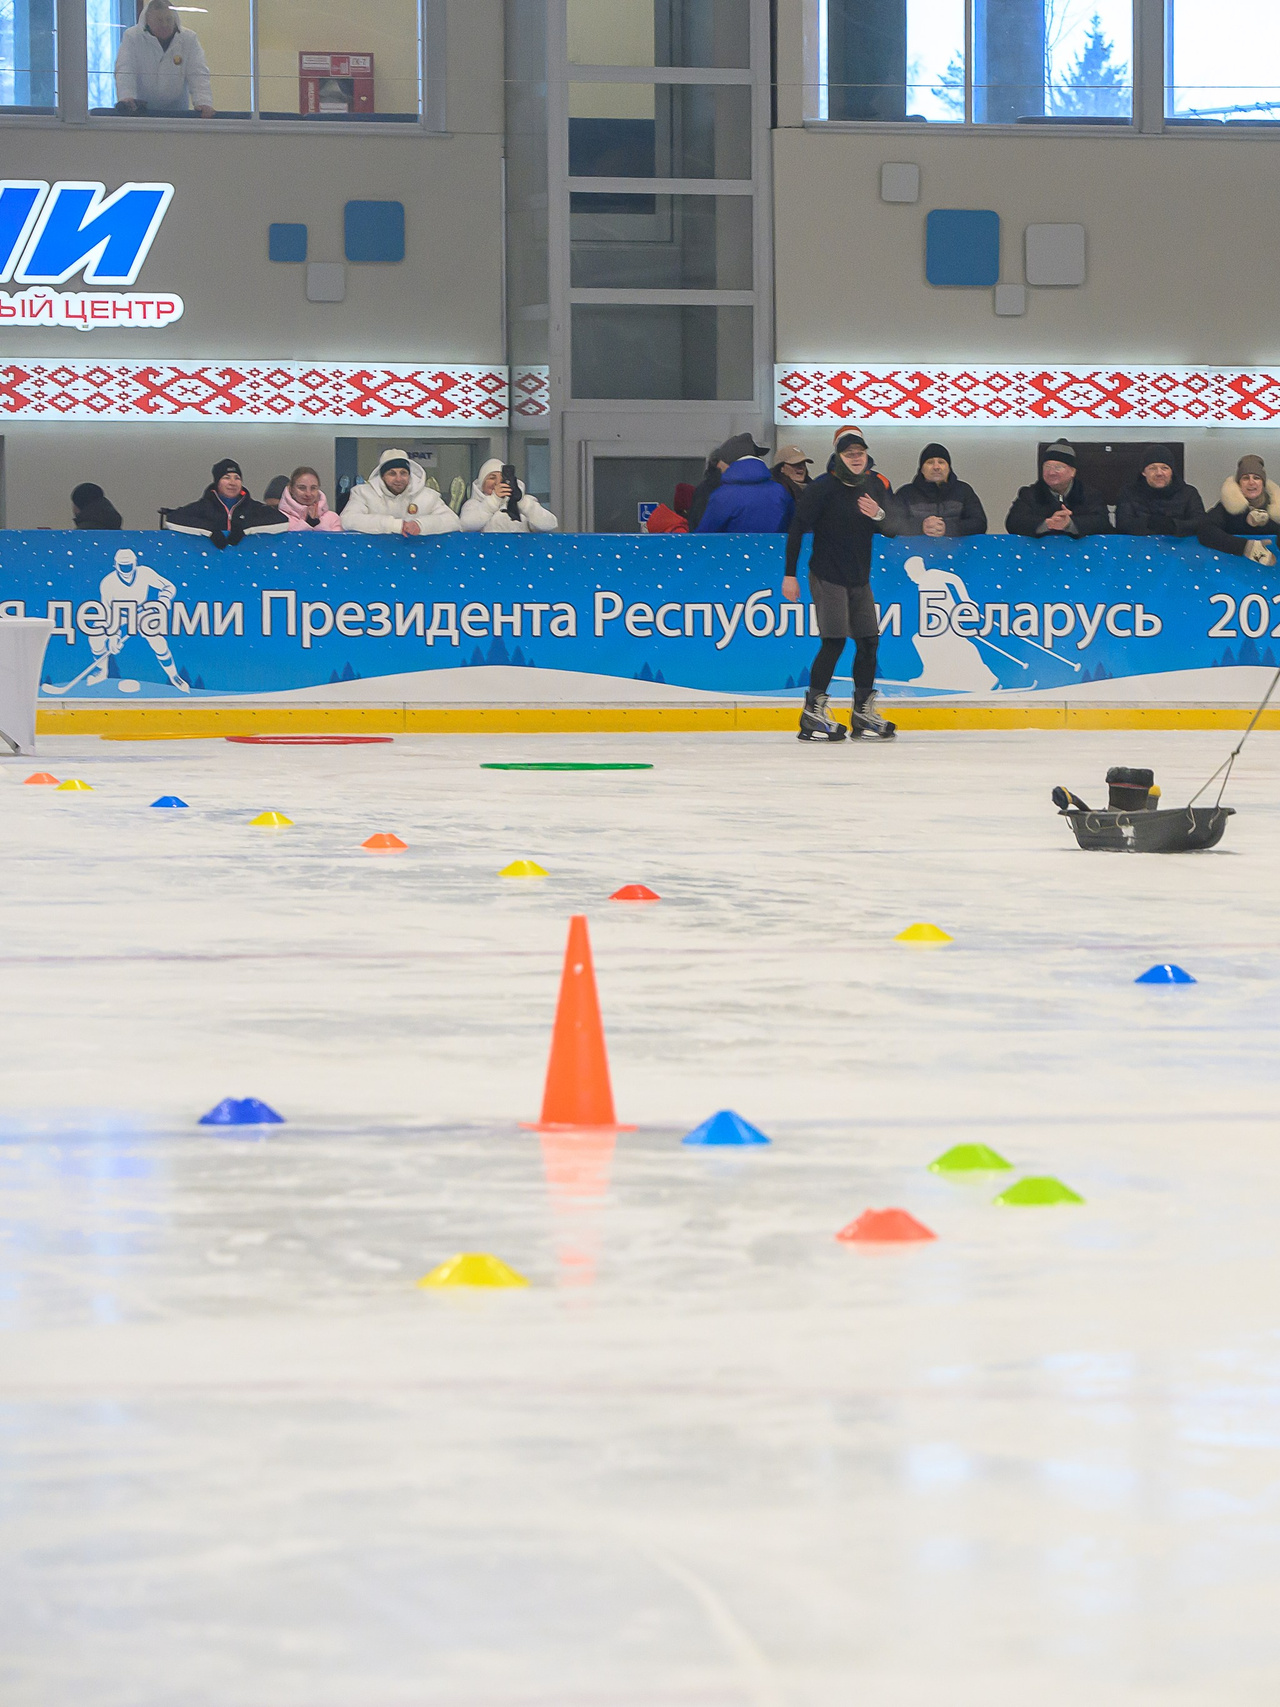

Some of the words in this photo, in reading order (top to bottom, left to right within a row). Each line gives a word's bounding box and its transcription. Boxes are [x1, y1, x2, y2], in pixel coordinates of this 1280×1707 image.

[65, 299, 175, 323] ЦЕНТР
[408, 452, 433, 460] ВРАТ
[47, 600, 244, 645] делами
[261, 589, 578, 649] Президента
[593, 588, 903, 651] Республи
[918, 590, 1163, 651] Беларусь
